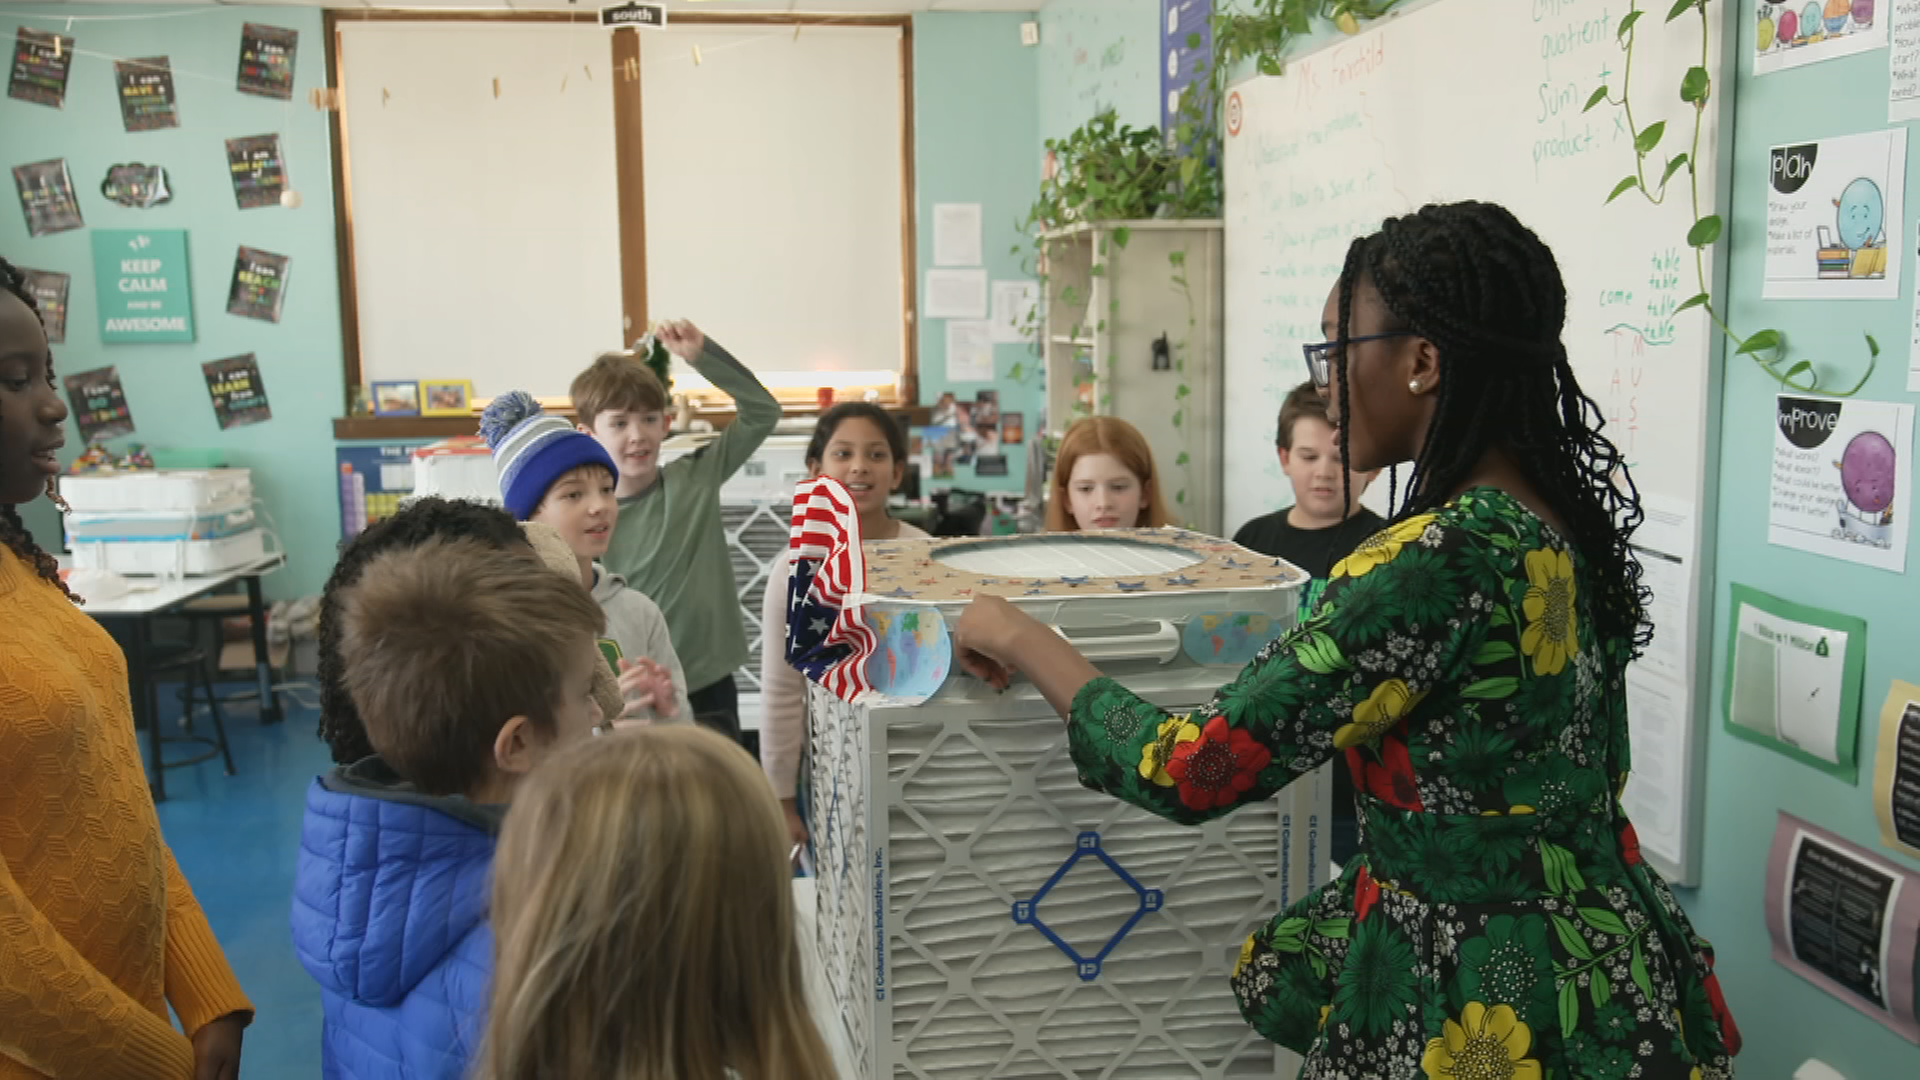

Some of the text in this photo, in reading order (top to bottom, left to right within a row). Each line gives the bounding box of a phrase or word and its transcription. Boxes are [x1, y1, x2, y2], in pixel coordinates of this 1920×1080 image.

[613, 8, 652, 22] south
[1772, 147, 1812, 187] plan
[121, 259, 162, 273] KEEP
[1651, 247, 1680, 272] table
[118, 278, 167, 293] CALM
[1649, 273, 1678, 290] table
[105, 317, 186, 332] AWESOME
[1282, 815, 1290, 827] CI
[1079, 837, 1096, 848] CI
[1146, 893, 1157, 908] CI
[1017, 903, 1030, 920] CI
[873, 847, 885, 1001] CI Columbus Industries, Inc.
[1080, 963, 1097, 974] CI
